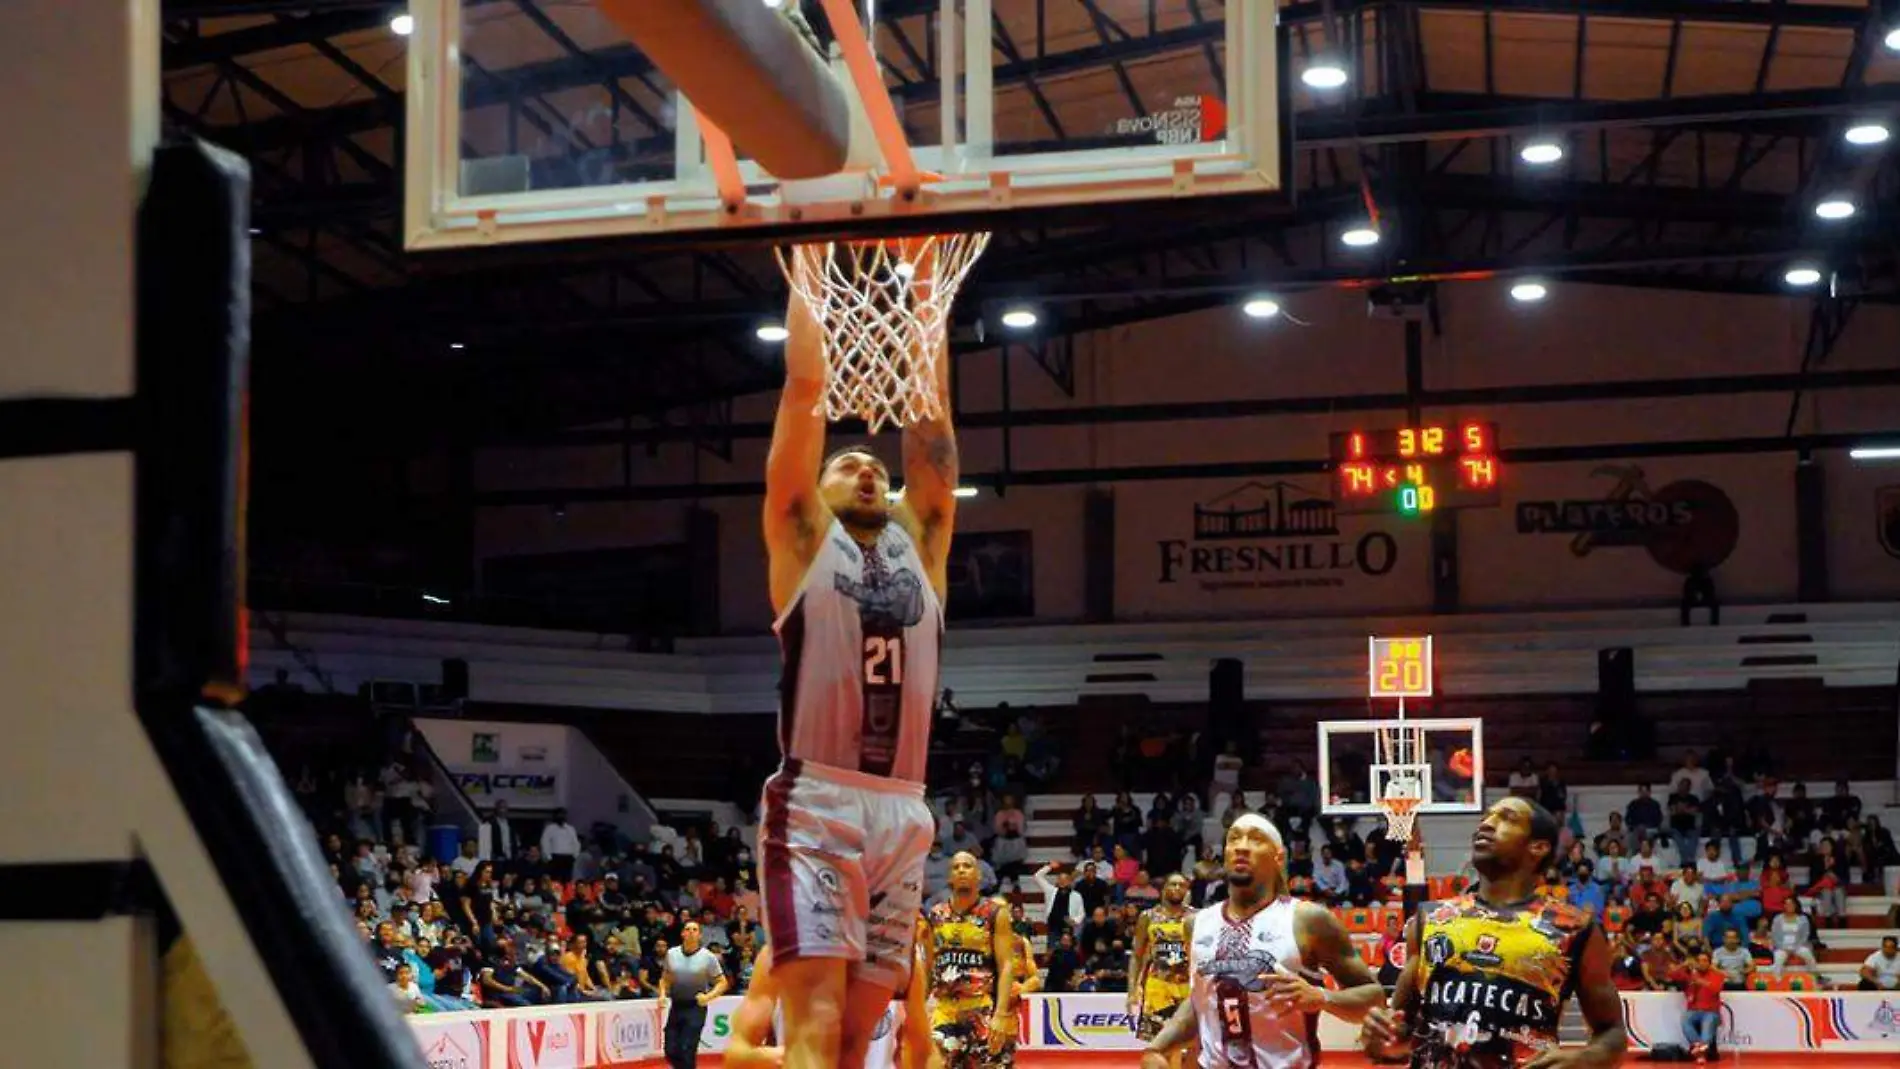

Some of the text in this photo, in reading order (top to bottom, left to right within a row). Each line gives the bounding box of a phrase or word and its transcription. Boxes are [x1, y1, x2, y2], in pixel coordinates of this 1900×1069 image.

[1354, 433, 1362, 458] 1
[1465, 425, 1482, 449] 5
[1343, 459, 1493, 493] 74 4 74
[1157, 531, 1398, 584] FRESNILLO
[864, 636, 902, 685] 21
[1380, 660, 1423, 691] 20
[1223, 998, 1242, 1034] 5
[1419, 981, 1543, 1020] ACATECAS
[713, 1014, 730, 1037] S
[1074, 1013, 1136, 1032] REFA
[1465, 1010, 1482, 1043] 6
